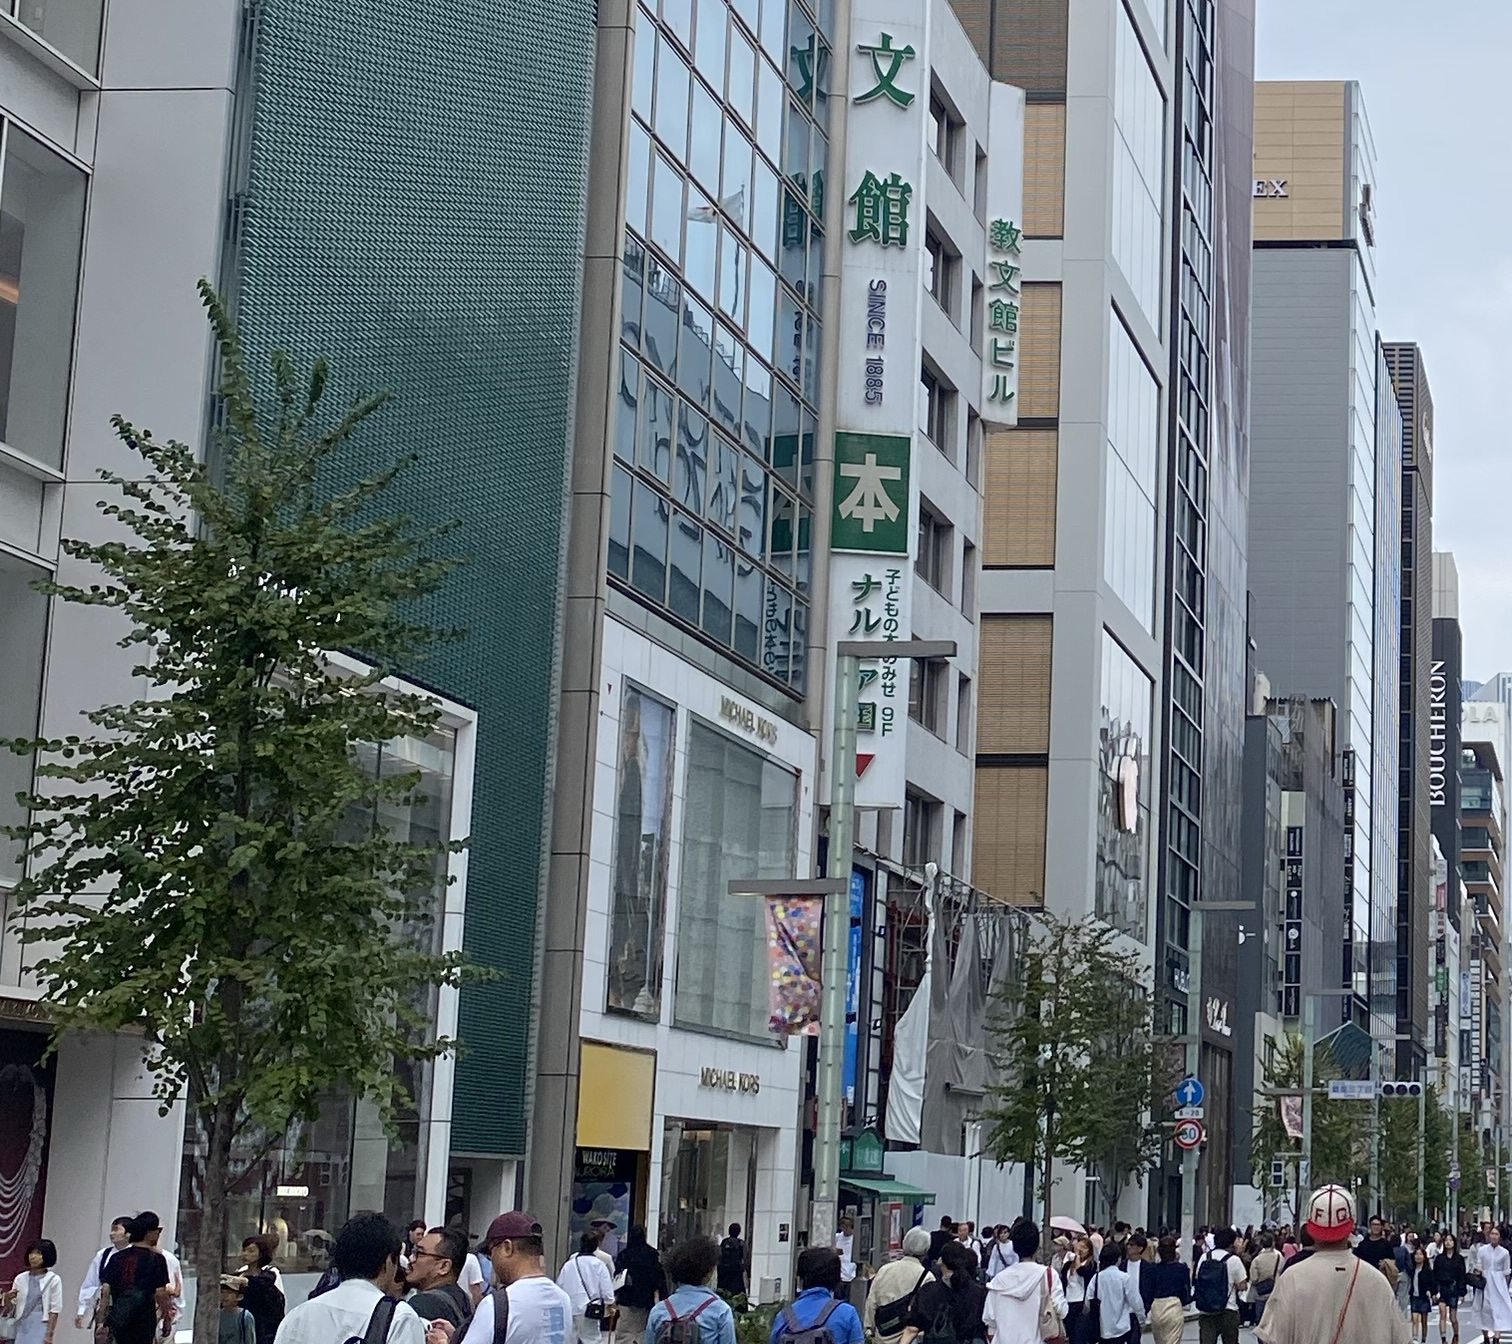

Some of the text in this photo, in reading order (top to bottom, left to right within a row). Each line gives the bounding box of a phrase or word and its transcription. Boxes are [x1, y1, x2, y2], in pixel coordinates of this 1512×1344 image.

[864, 279, 888, 406] SINCE 1885
[989, 218, 1021, 403] 教文館ビル
[838, 453, 902, 532] 本
[850, 573, 882, 732] ナルア国
[881, 707, 895, 737] 9F
[1430, 660, 1447, 805] BOUCHERON
[700, 1066, 760, 1094] MICHAEL KORS
